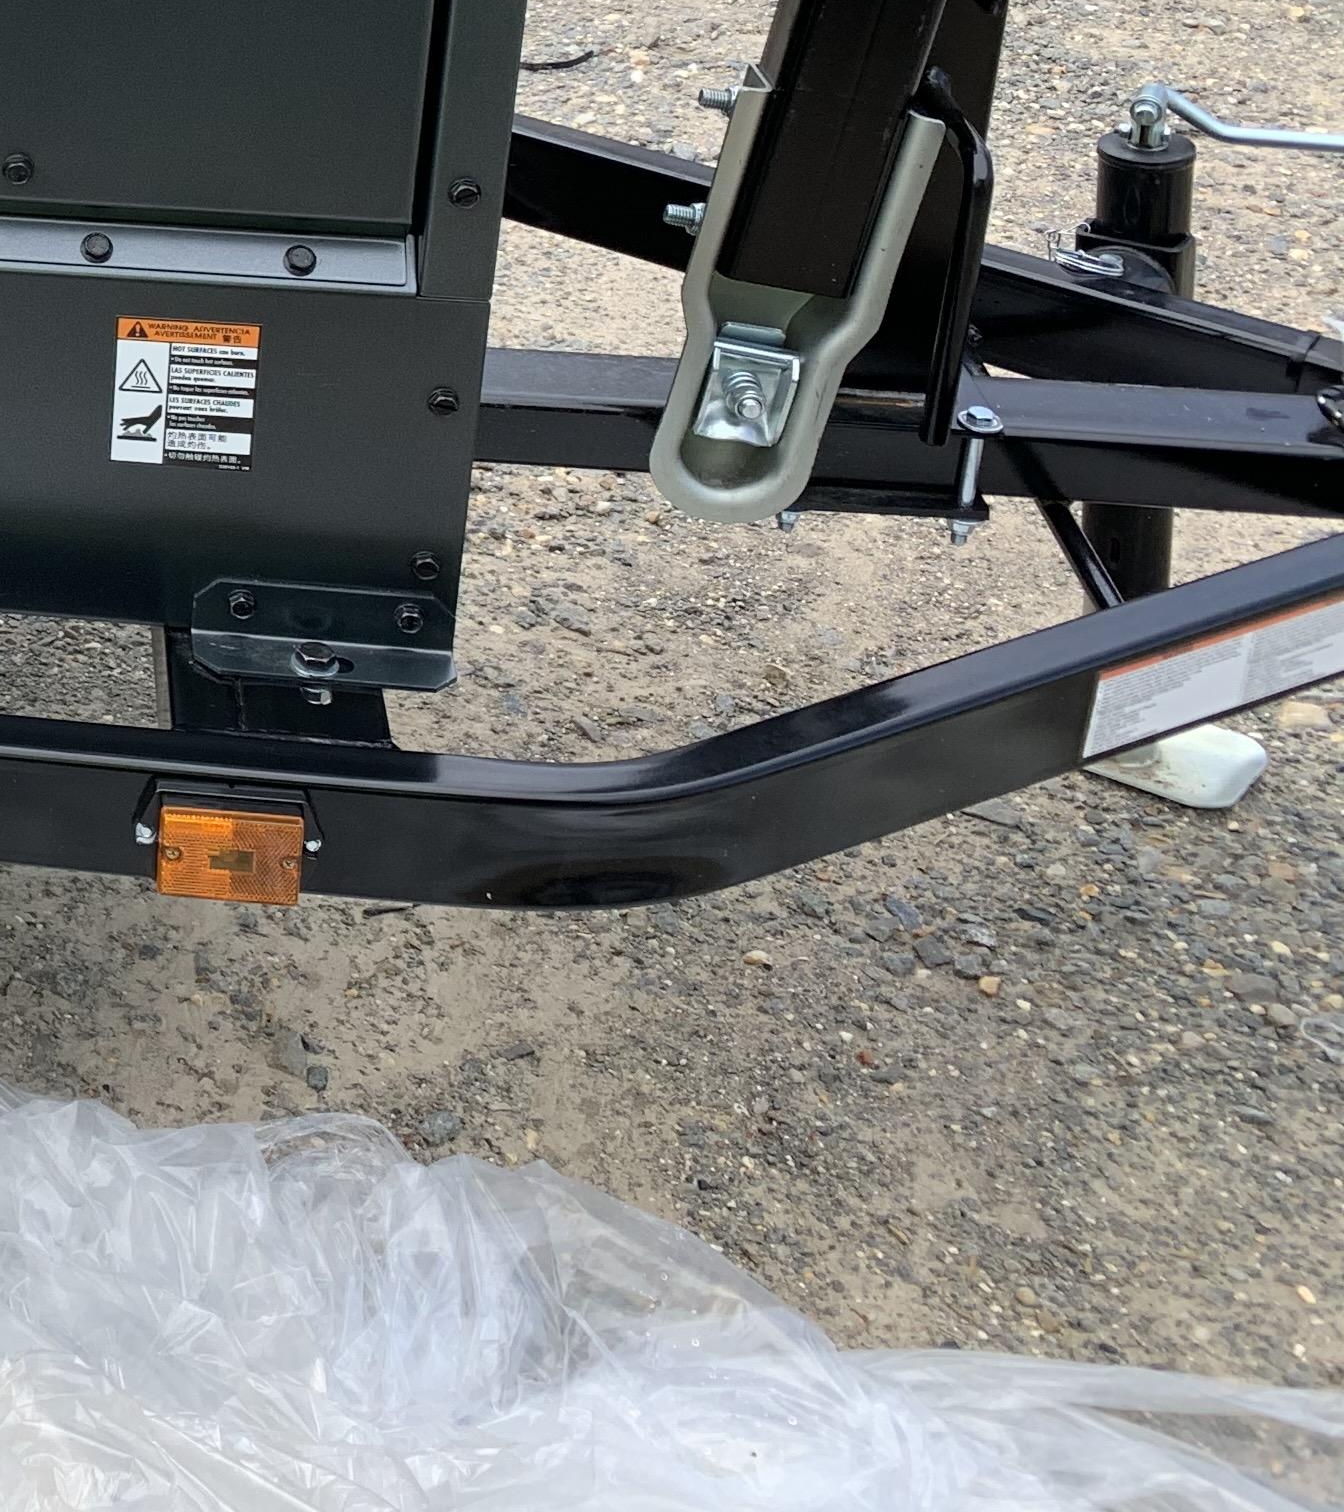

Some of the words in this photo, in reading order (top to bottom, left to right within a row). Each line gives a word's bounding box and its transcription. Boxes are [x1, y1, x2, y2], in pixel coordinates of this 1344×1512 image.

[148, 323, 188, 331] WARNING
[193, 326, 250, 335] ADVERTENCIA
[184, 368, 221, 376] SUPERFICIES
